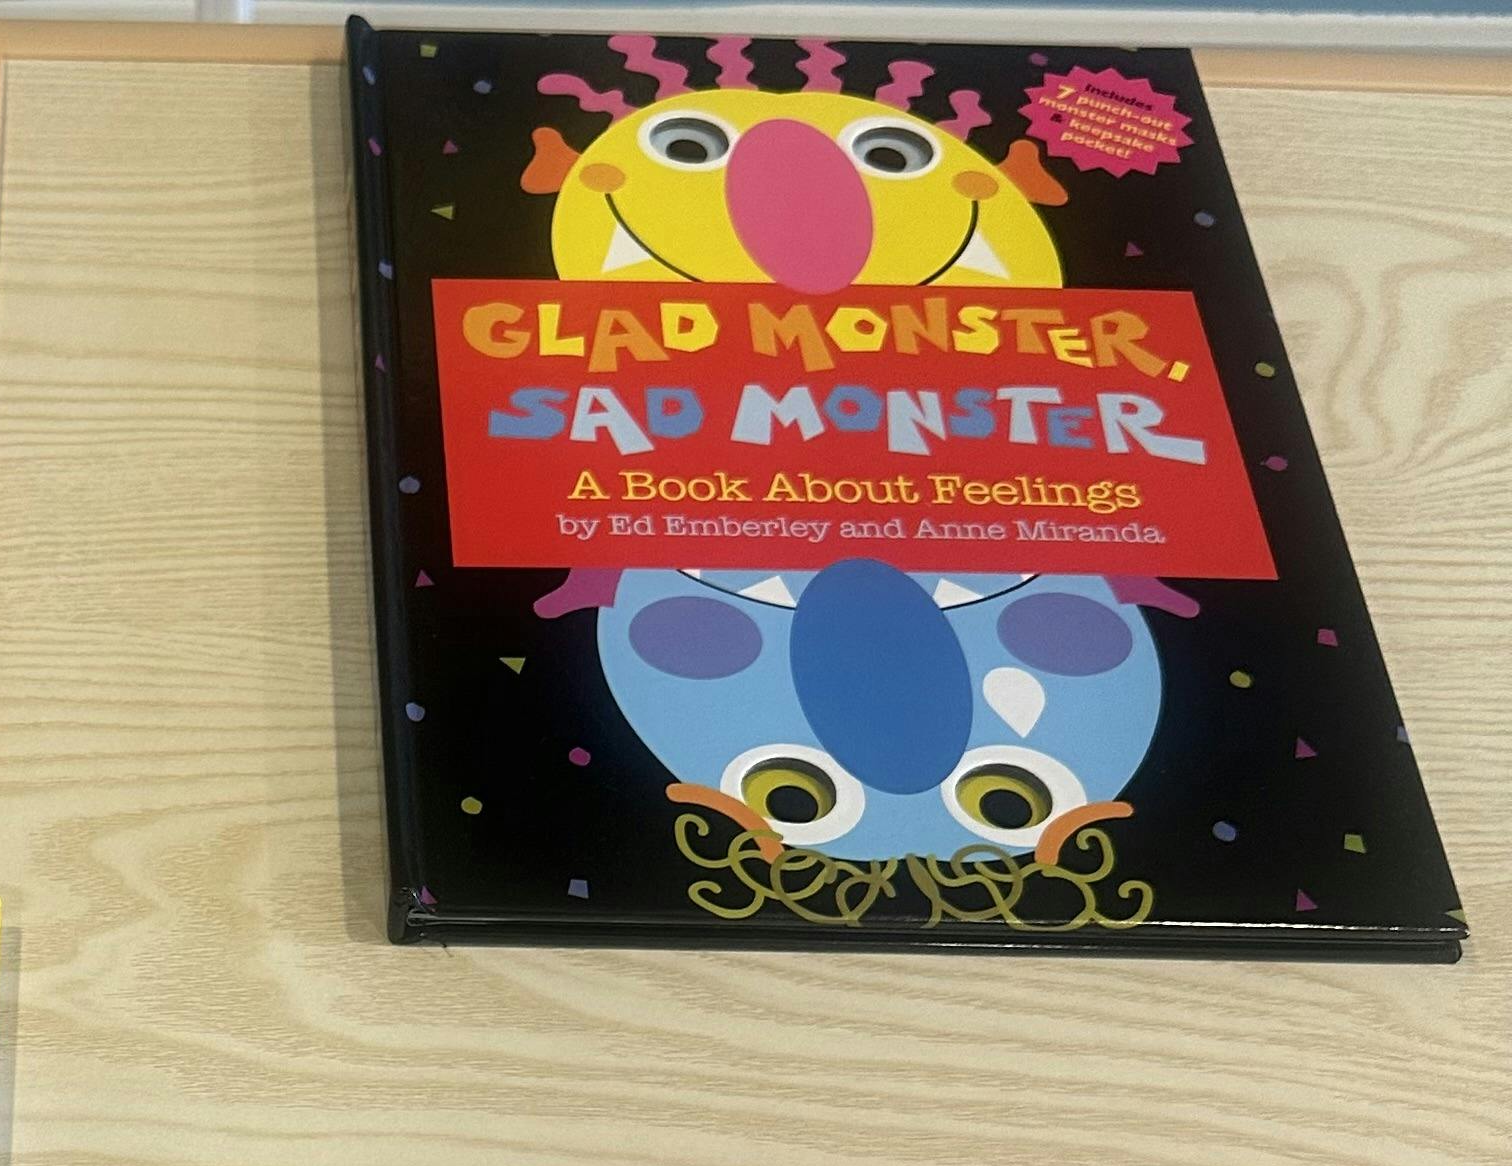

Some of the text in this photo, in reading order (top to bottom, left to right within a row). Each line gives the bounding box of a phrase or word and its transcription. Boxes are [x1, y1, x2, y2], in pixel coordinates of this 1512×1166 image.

[1056, 84, 1173, 131] 7 punch-out
[1084, 83, 1153, 111] Includes
[1038, 96, 1176, 146] monster masks
[1069, 119, 1155, 152] keepsake
[463, 298, 1191, 383] GLAD MONSTER,
[489, 384, 1207, 466] SAD MONSTER
[567, 471, 1141, 514] A Book About Feelings
[555, 513, 1166, 543] by Ed Emberley and Anne Miranda
